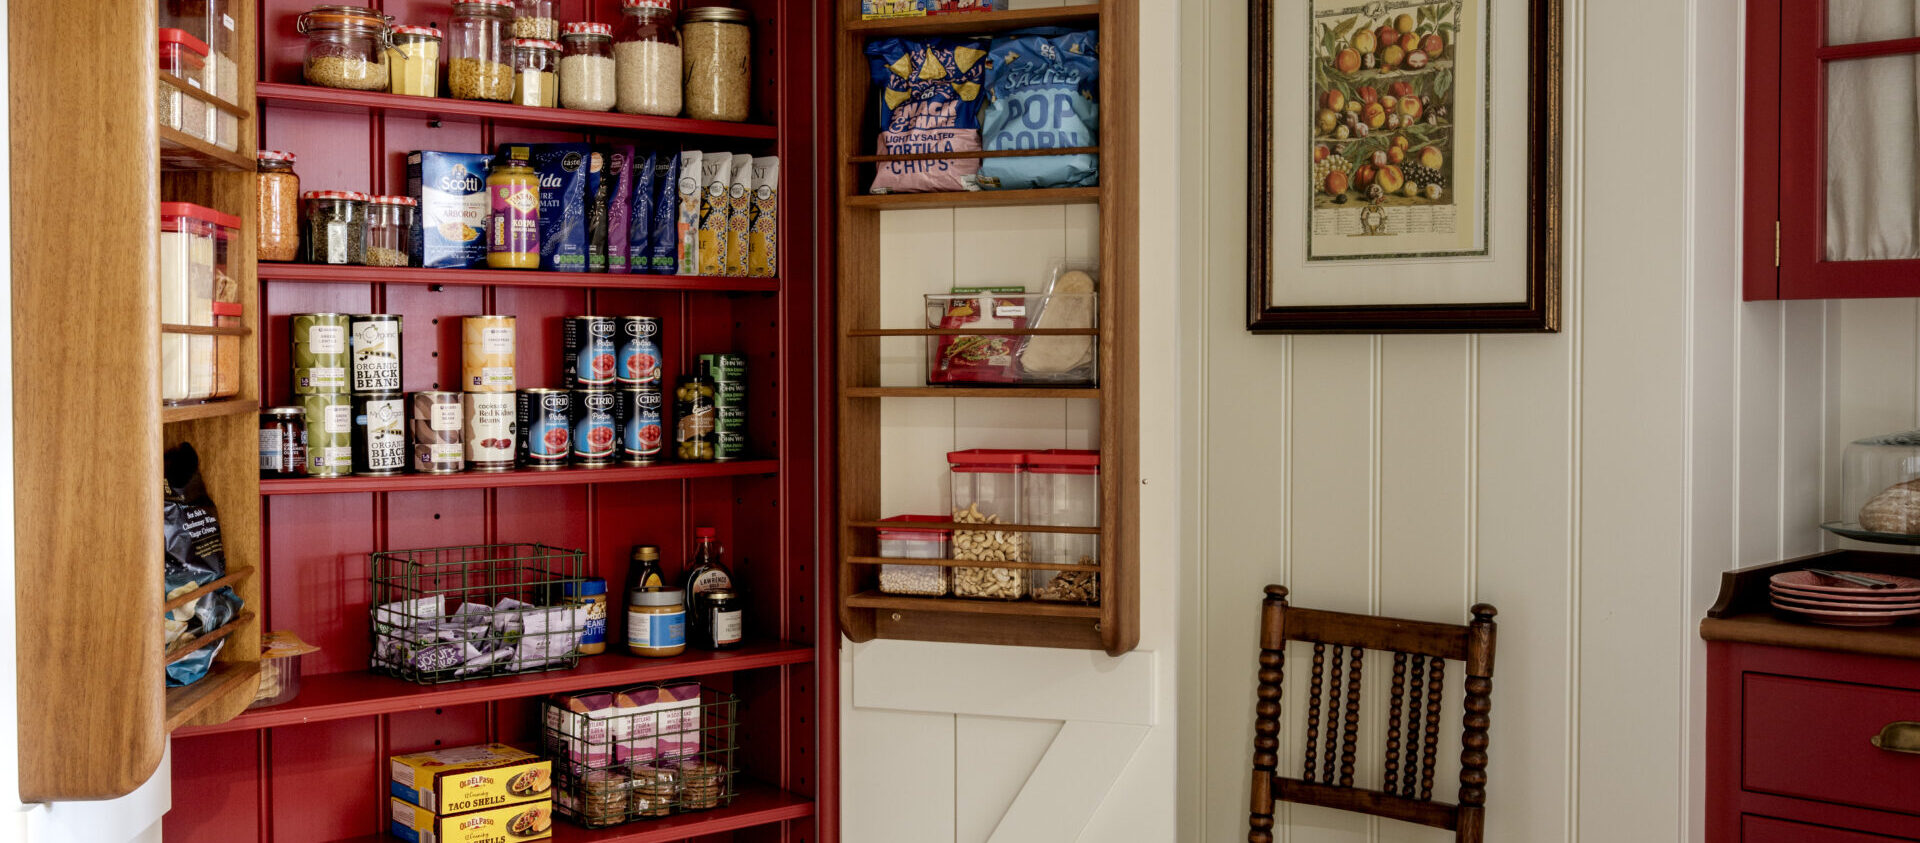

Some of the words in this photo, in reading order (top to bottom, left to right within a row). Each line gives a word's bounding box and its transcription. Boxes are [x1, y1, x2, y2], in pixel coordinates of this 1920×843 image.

[892, 100, 958, 120] SNACK
[1000, 94, 1074, 130] POP
[889, 116, 906, 134] &
[908, 115, 956, 130] SHARE
[885, 133, 919, 143] LIGHTLY
[921, 132, 955, 141] SALTED
[996, 131, 1078, 151] CORN
[887, 141, 954, 155] TORTILLA
[891, 159, 949, 175] CHIPS
[442, 176, 478, 191] Scotti
[628, 323, 655, 332] CIRIO
[356, 362, 398, 370] ORGANIC
[357, 370, 397, 378] BLACK
[357, 378, 398, 388] BEANS
[588, 396, 613, 406] CIRIO
[448, 801, 471, 811] TACO
[472, 795, 506, 807] SHELLS
